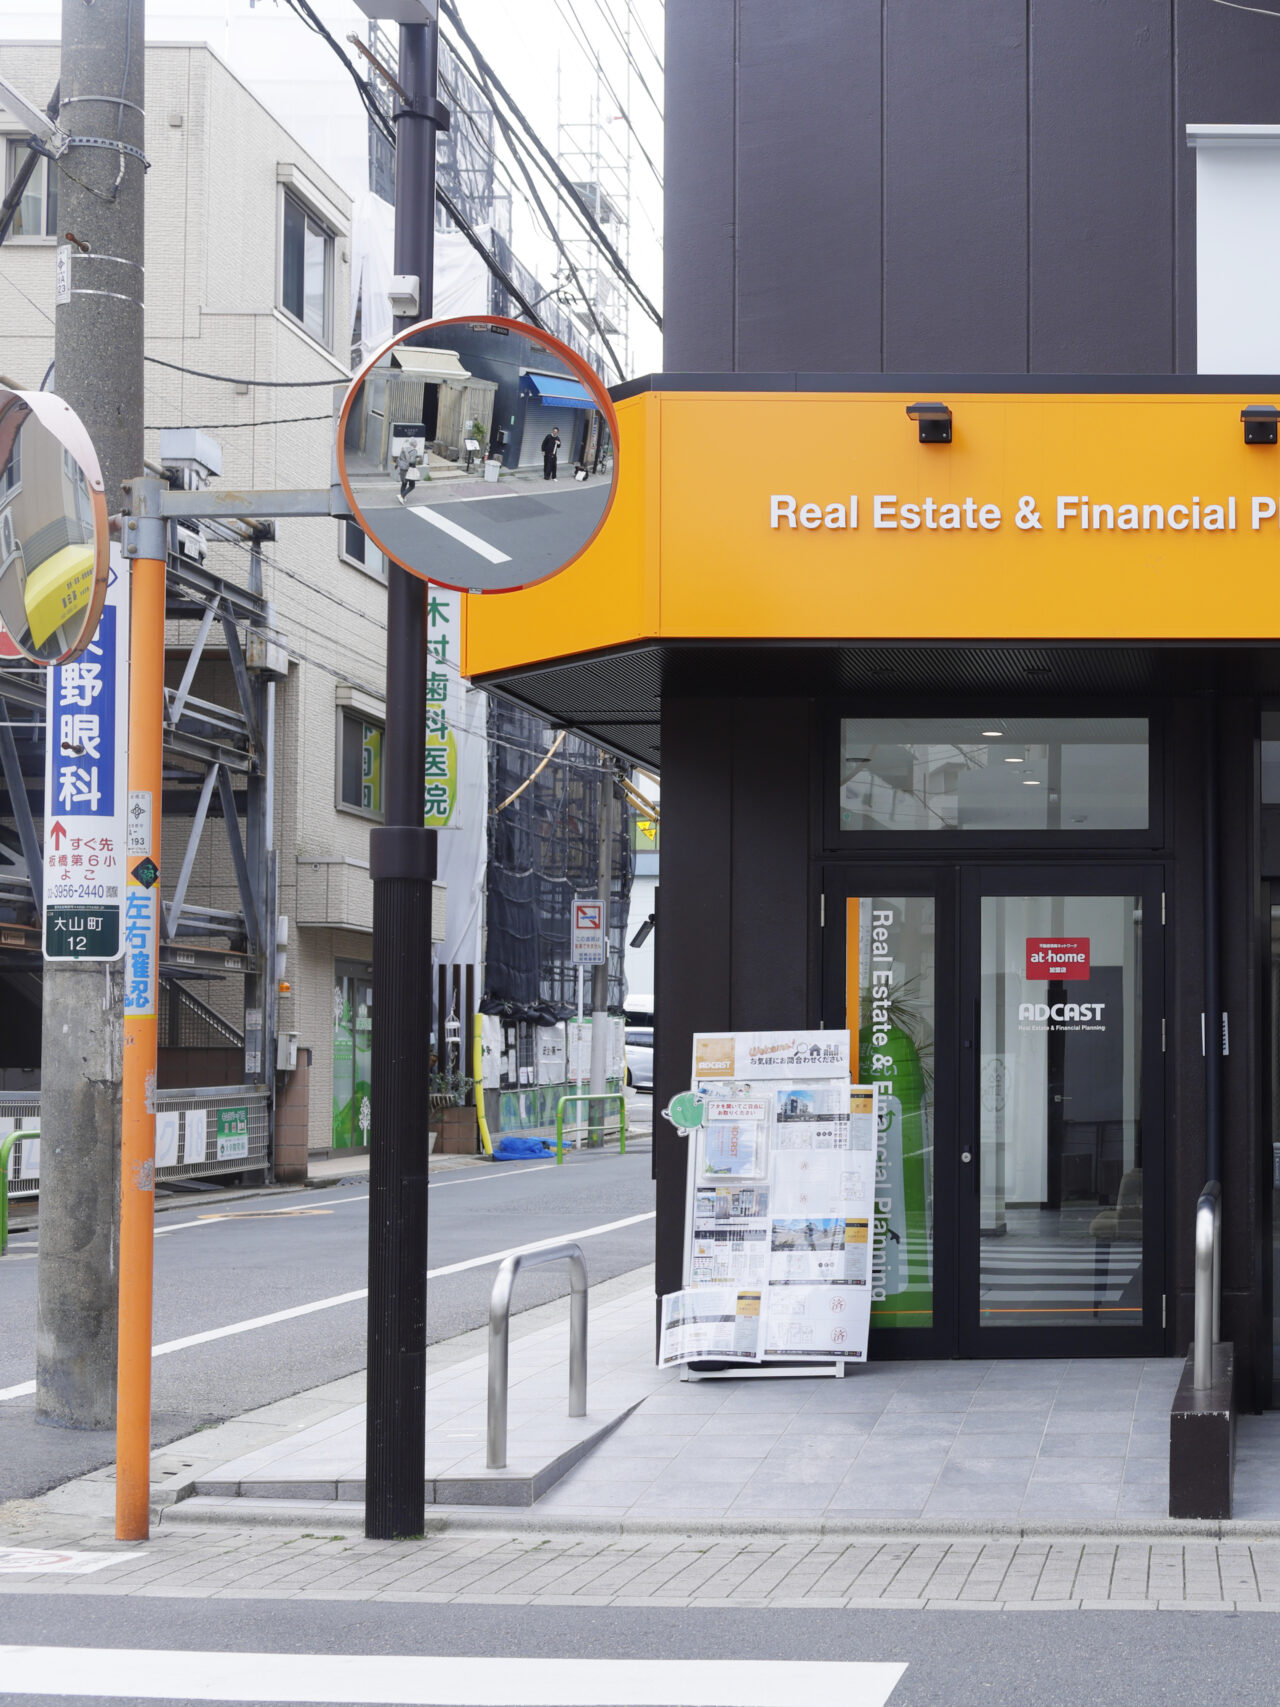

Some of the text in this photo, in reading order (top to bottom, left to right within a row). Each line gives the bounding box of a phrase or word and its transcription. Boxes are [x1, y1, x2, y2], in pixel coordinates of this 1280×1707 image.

[769, 494, 860, 530] Real
[873, 494, 1002, 530] Estate
[1014, 494, 1043, 530] &
[1055, 494, 1237, 530] Financial
[59, 613, 104, 812] 野眼科
[70, 837, 114, 852] すぐ先
[48, 854, 117, 867] 板橋第6小
[60, 869, 96, 881] よこ
[54, 916, 104, 932] 大山町
[67, 936, 87, 951] 12
[872, 910, 893, 962] Real
[1030, 949, 1086, 963] at home
[872, 969, 893, 1047] Estate
[1018, 1003, 1106, 1021] ADCAST
[750, 1056, 844, 1066] お気軽にお問合わせください
[872, 1053, 893, 1071] &
